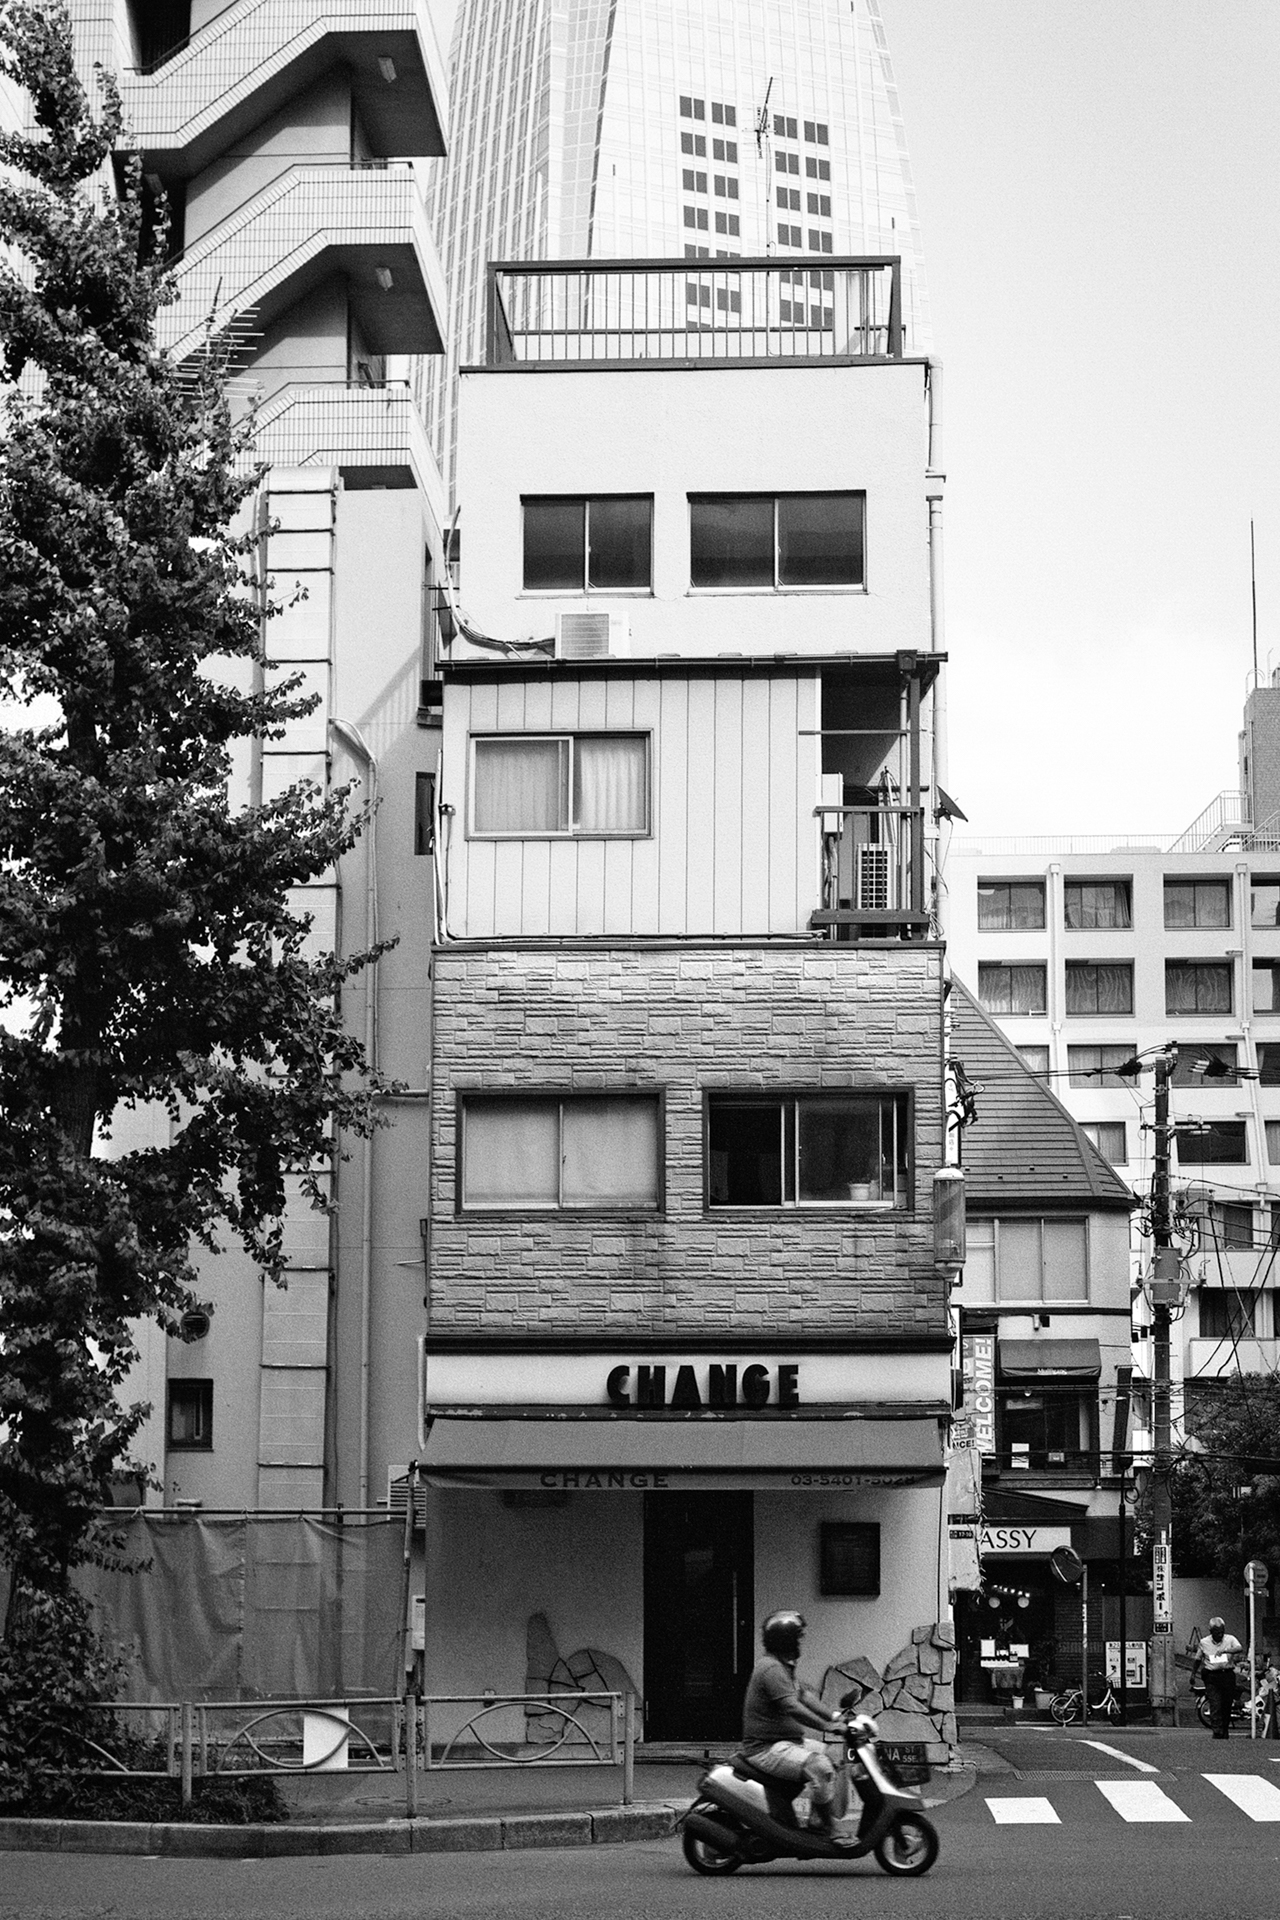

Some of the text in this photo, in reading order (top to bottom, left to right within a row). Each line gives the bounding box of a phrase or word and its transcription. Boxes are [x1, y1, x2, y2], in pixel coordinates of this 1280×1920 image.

[607, 1364, 799, 1409] CHANGE
[541, 1473, 669, 1487] CHANGE
[981, 1529, 1036, 1549] ASSY
